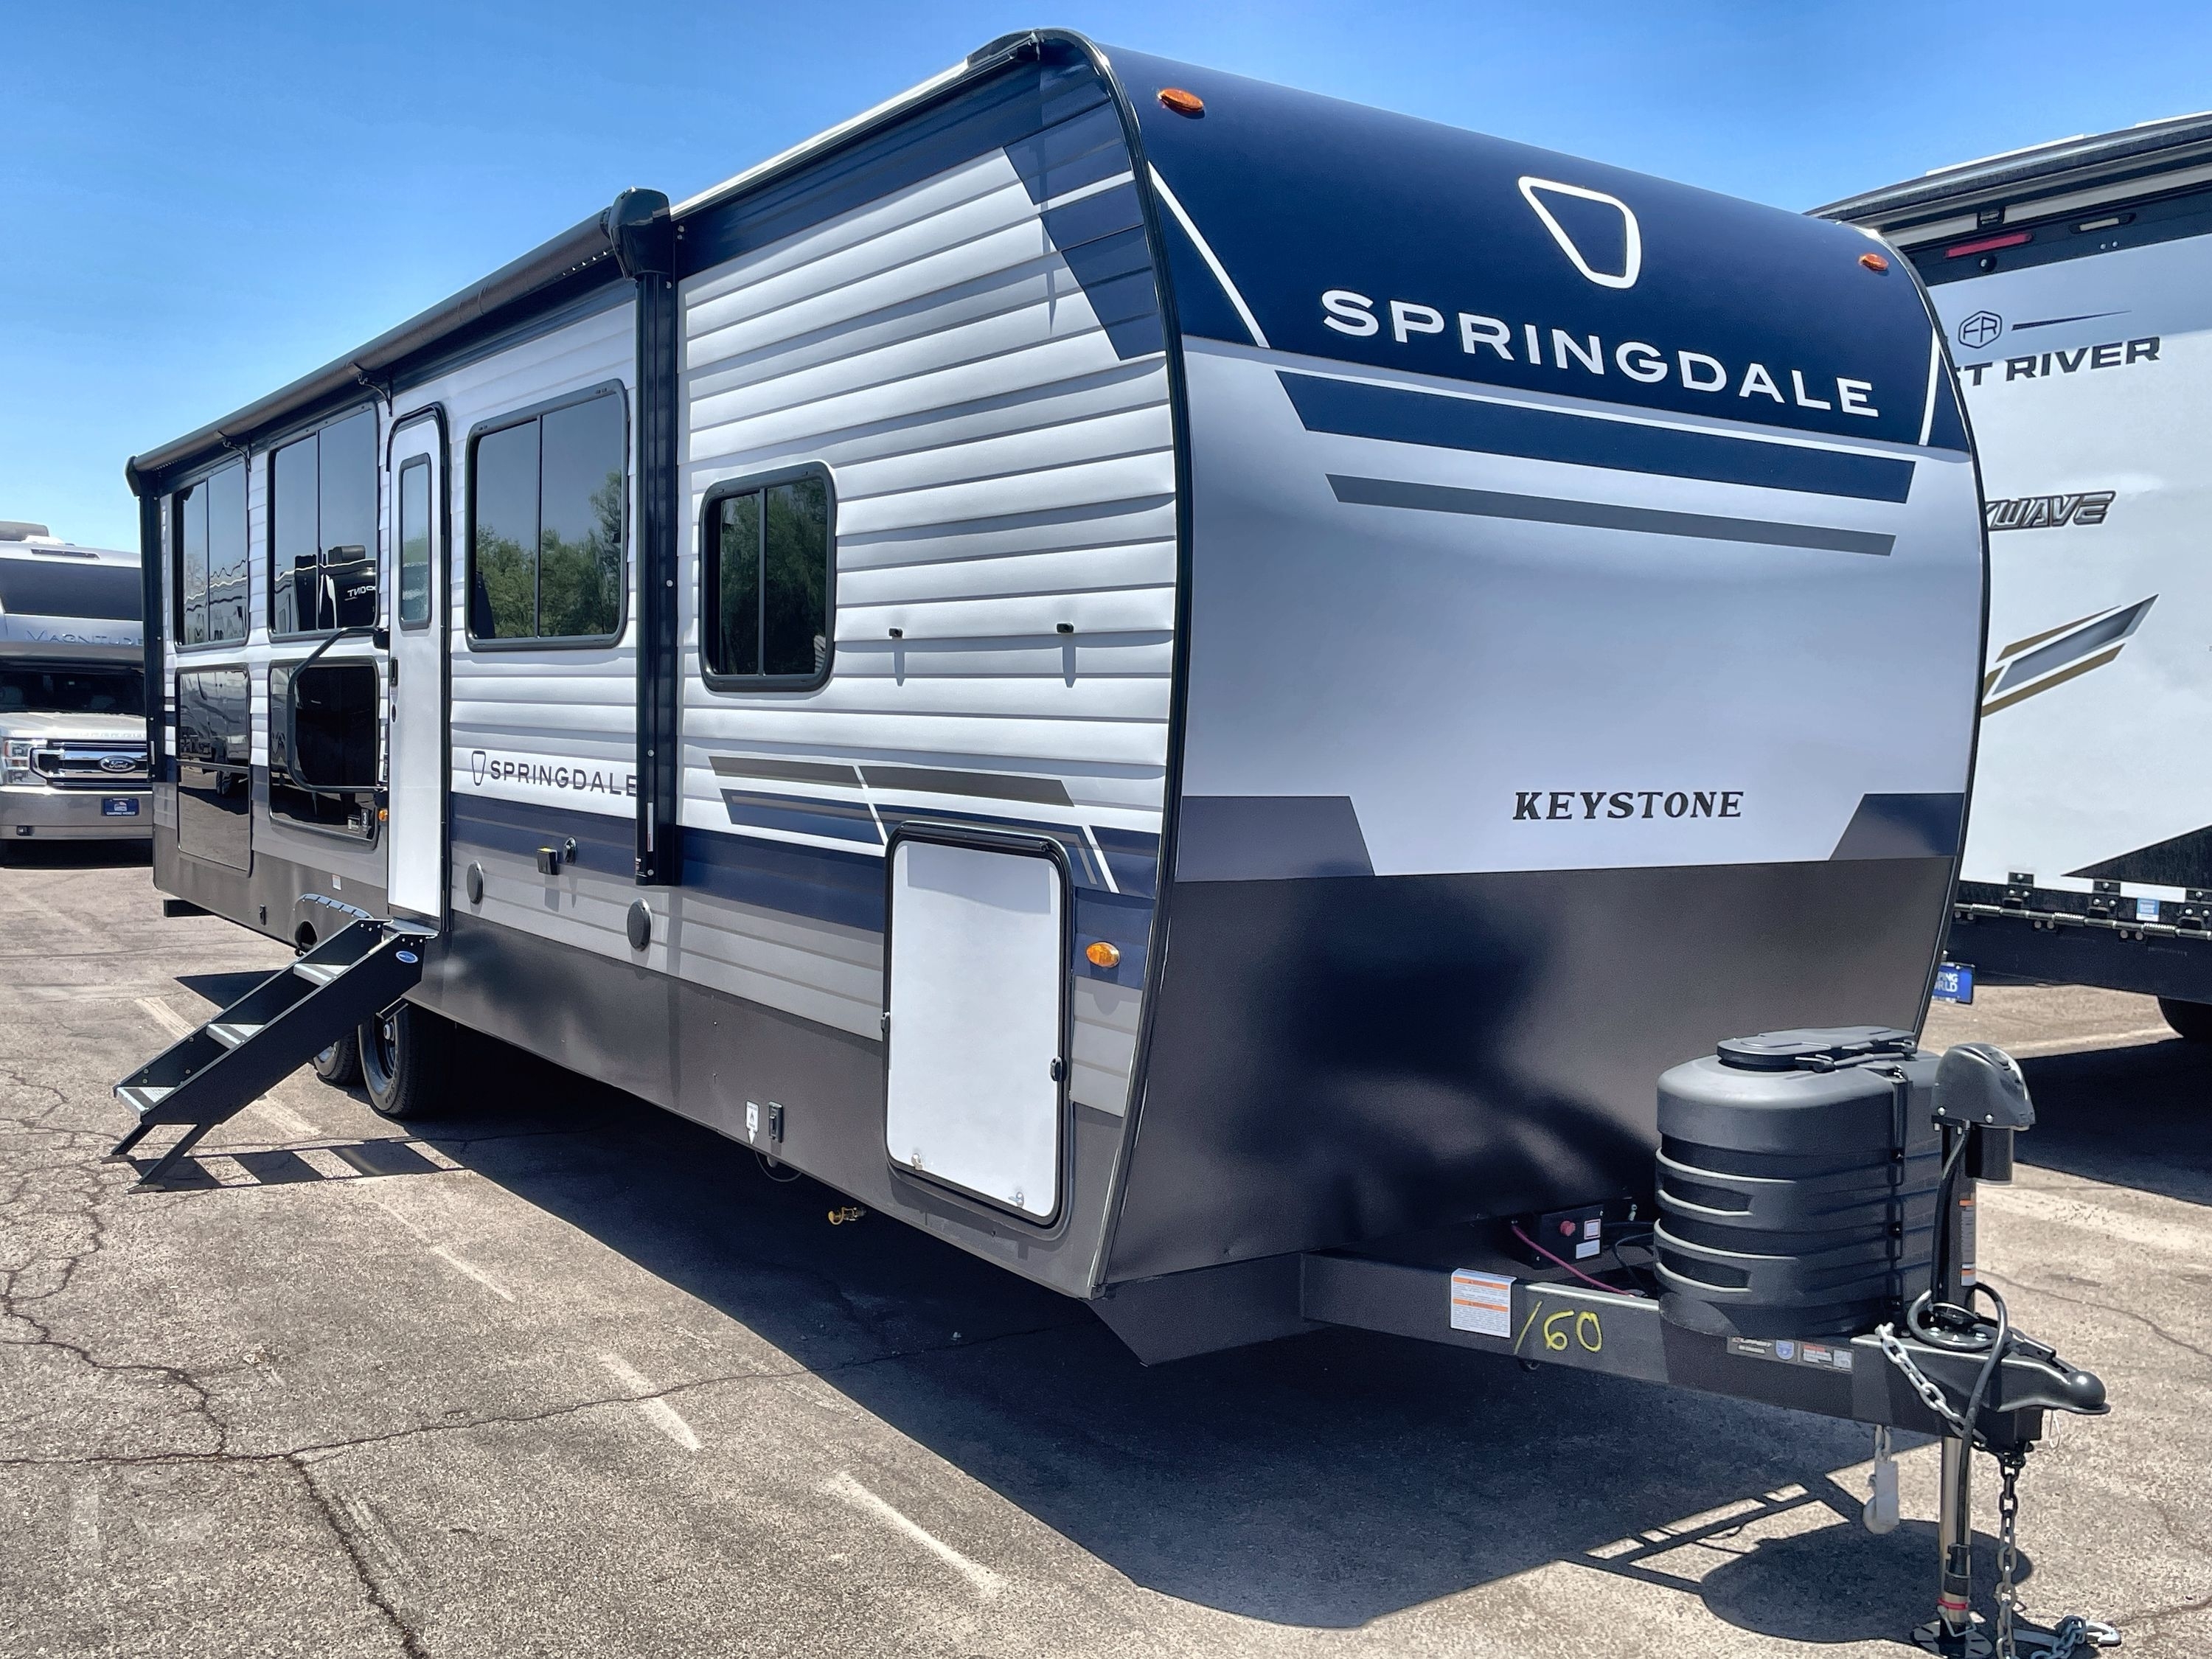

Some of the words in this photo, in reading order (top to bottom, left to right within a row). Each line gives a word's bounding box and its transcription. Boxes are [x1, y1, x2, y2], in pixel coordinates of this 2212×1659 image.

[1321, 290, 1879, 417] SPRINGDALE
[2005, 336, 2160, 381] RIVER
[1513, 791, 1744, 820] KEYSTONE
